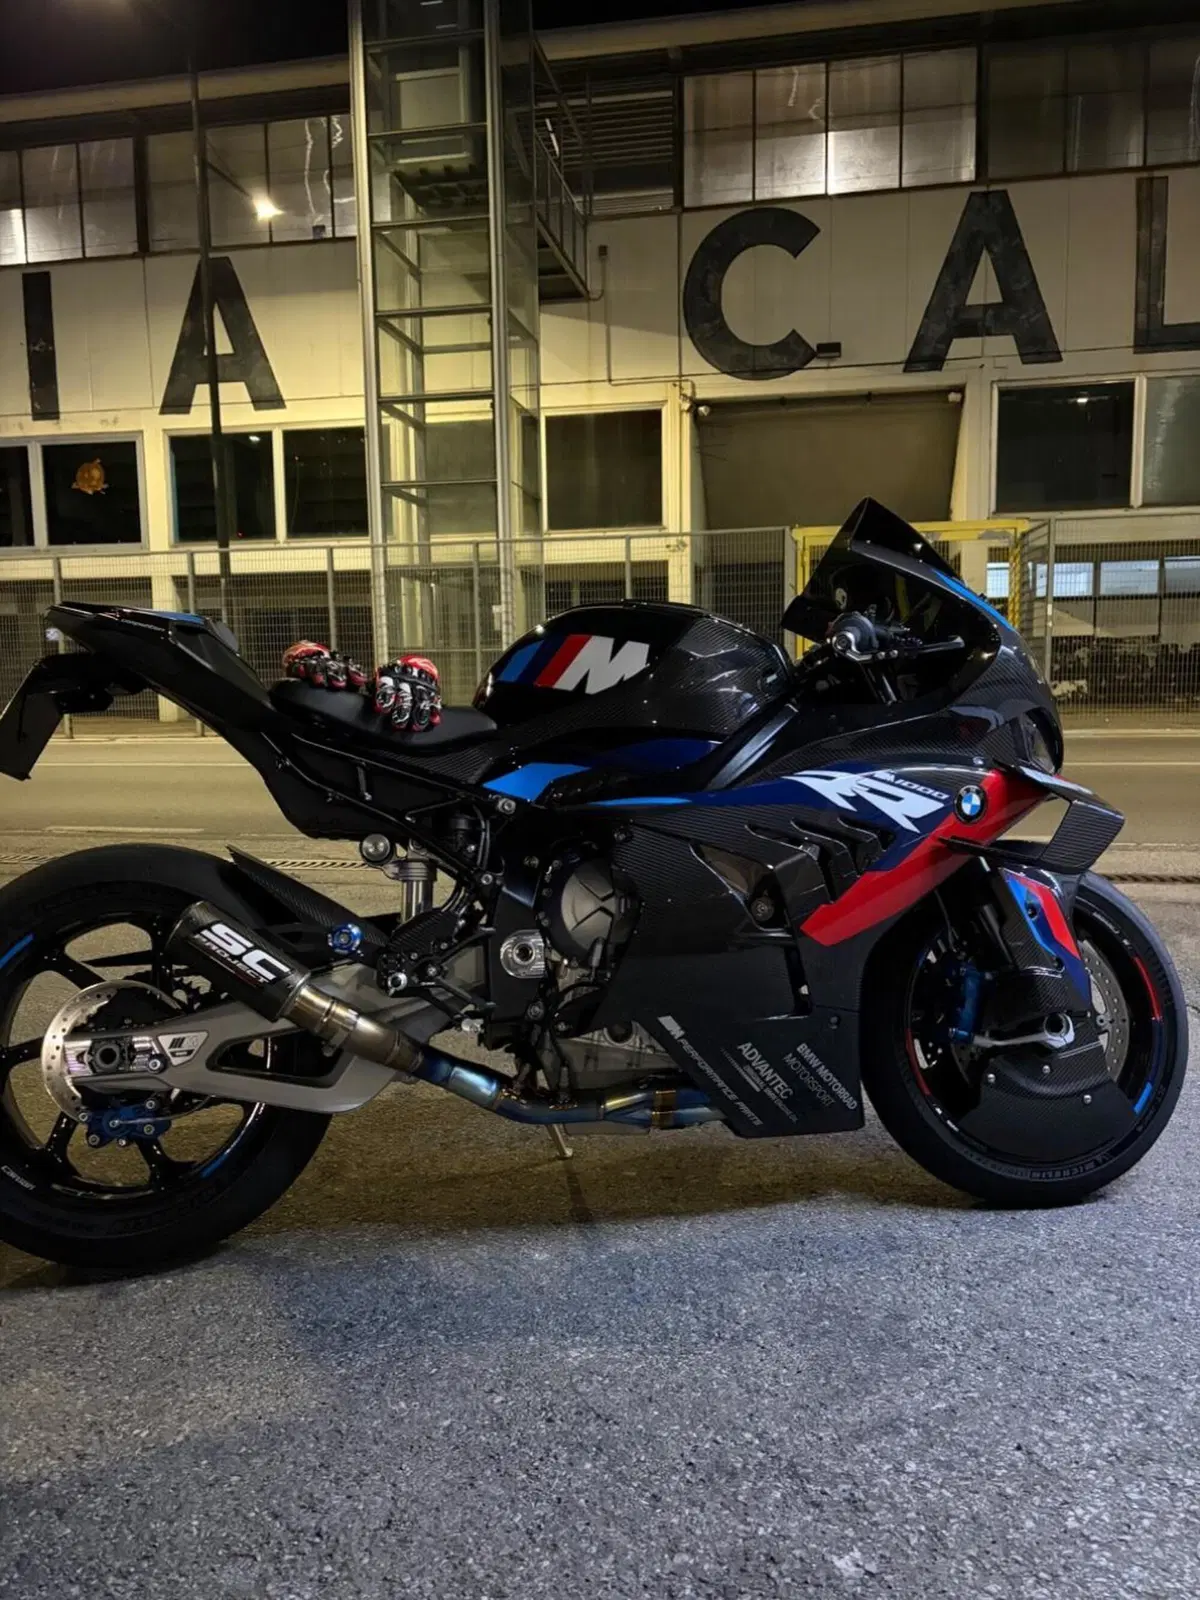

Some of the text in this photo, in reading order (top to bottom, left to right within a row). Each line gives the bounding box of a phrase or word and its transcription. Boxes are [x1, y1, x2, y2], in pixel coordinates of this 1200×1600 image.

[683, 176, 1200, 380] CAL
[199, 923, 292, 981] SC
[737, 1042, 794, 1100] ADVANTEC
[782, 1052, 837, 1107] MOTORSPORT
[796, 1043, 858, 1110] BMW MOTORRAD
